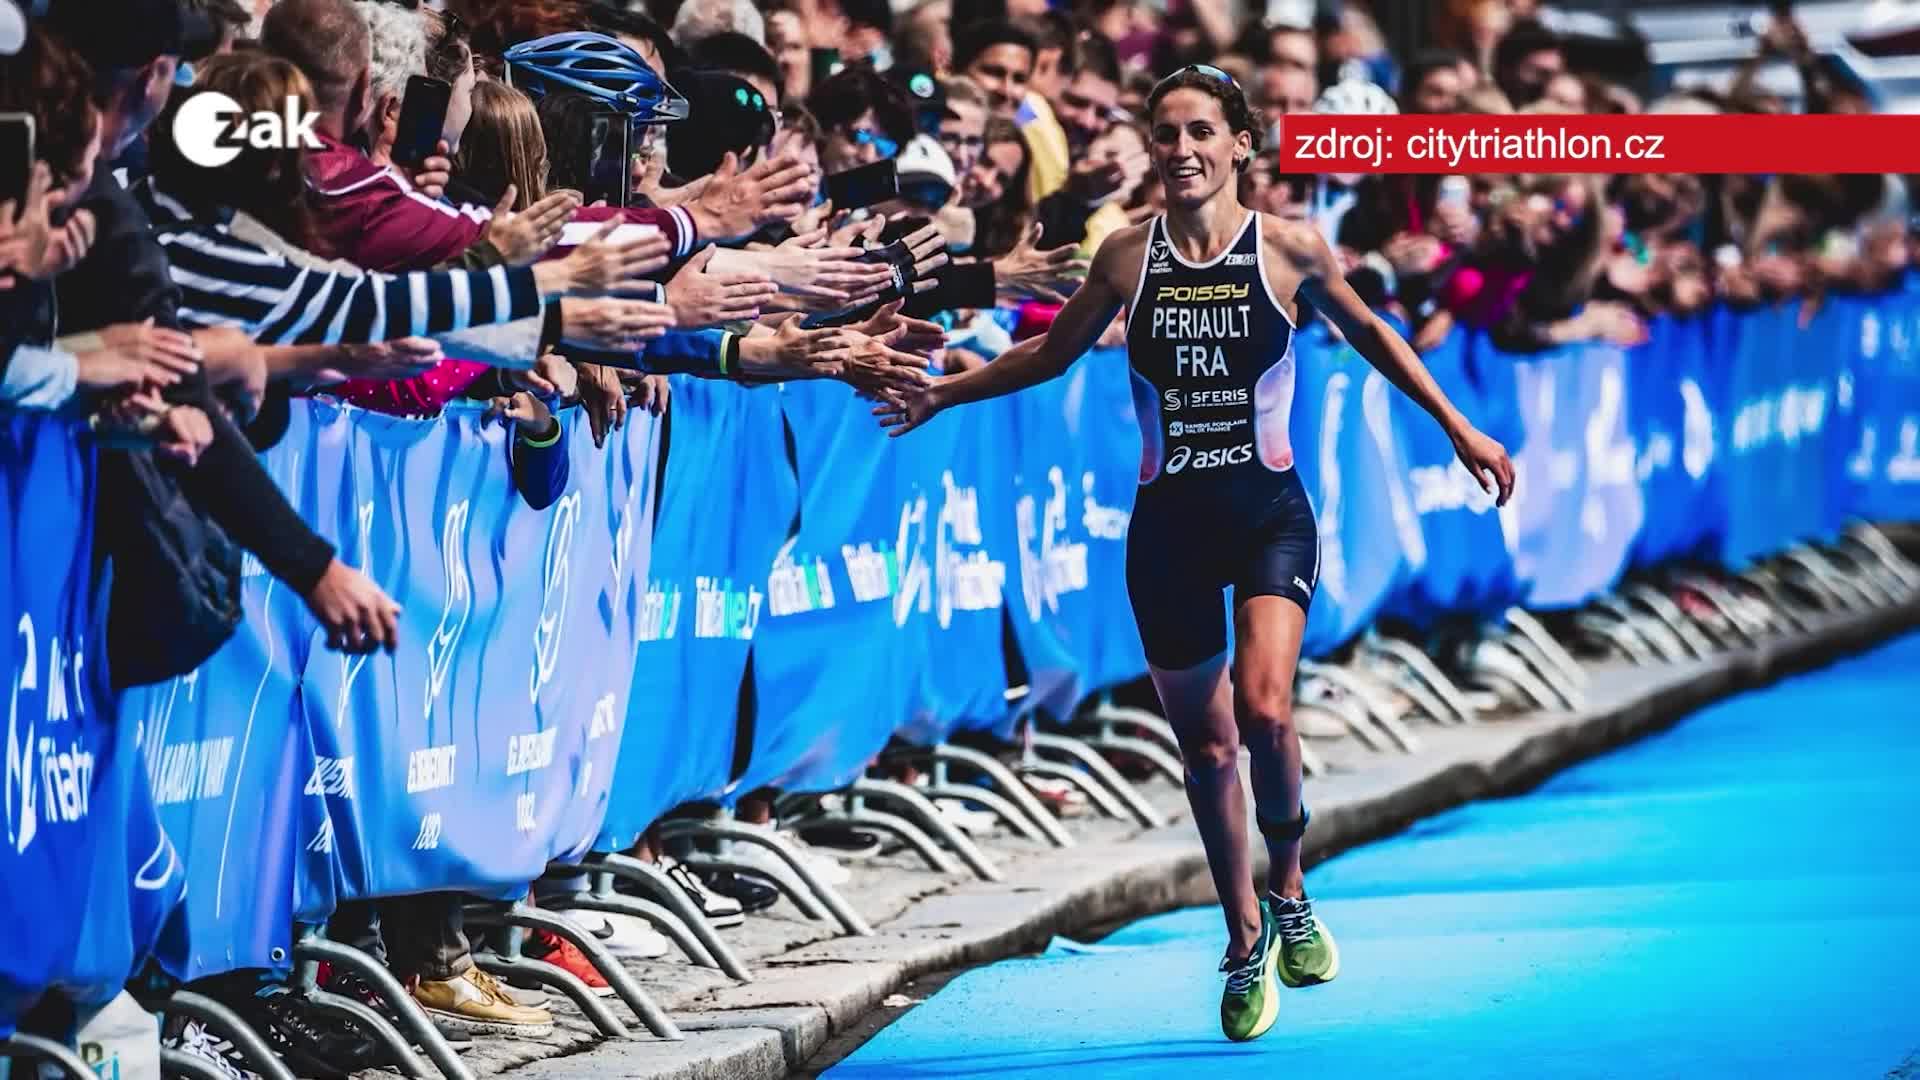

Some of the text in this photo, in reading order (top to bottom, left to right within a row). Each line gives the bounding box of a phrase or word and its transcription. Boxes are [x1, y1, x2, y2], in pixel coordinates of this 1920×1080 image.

[1156, 283, 1250, 302] POISSY
[1152, 305, 1250, 339] PERIAULT
[1175, 345, 1230, 377] FRA
[1191, 388, 1249, 403] SFERIS
